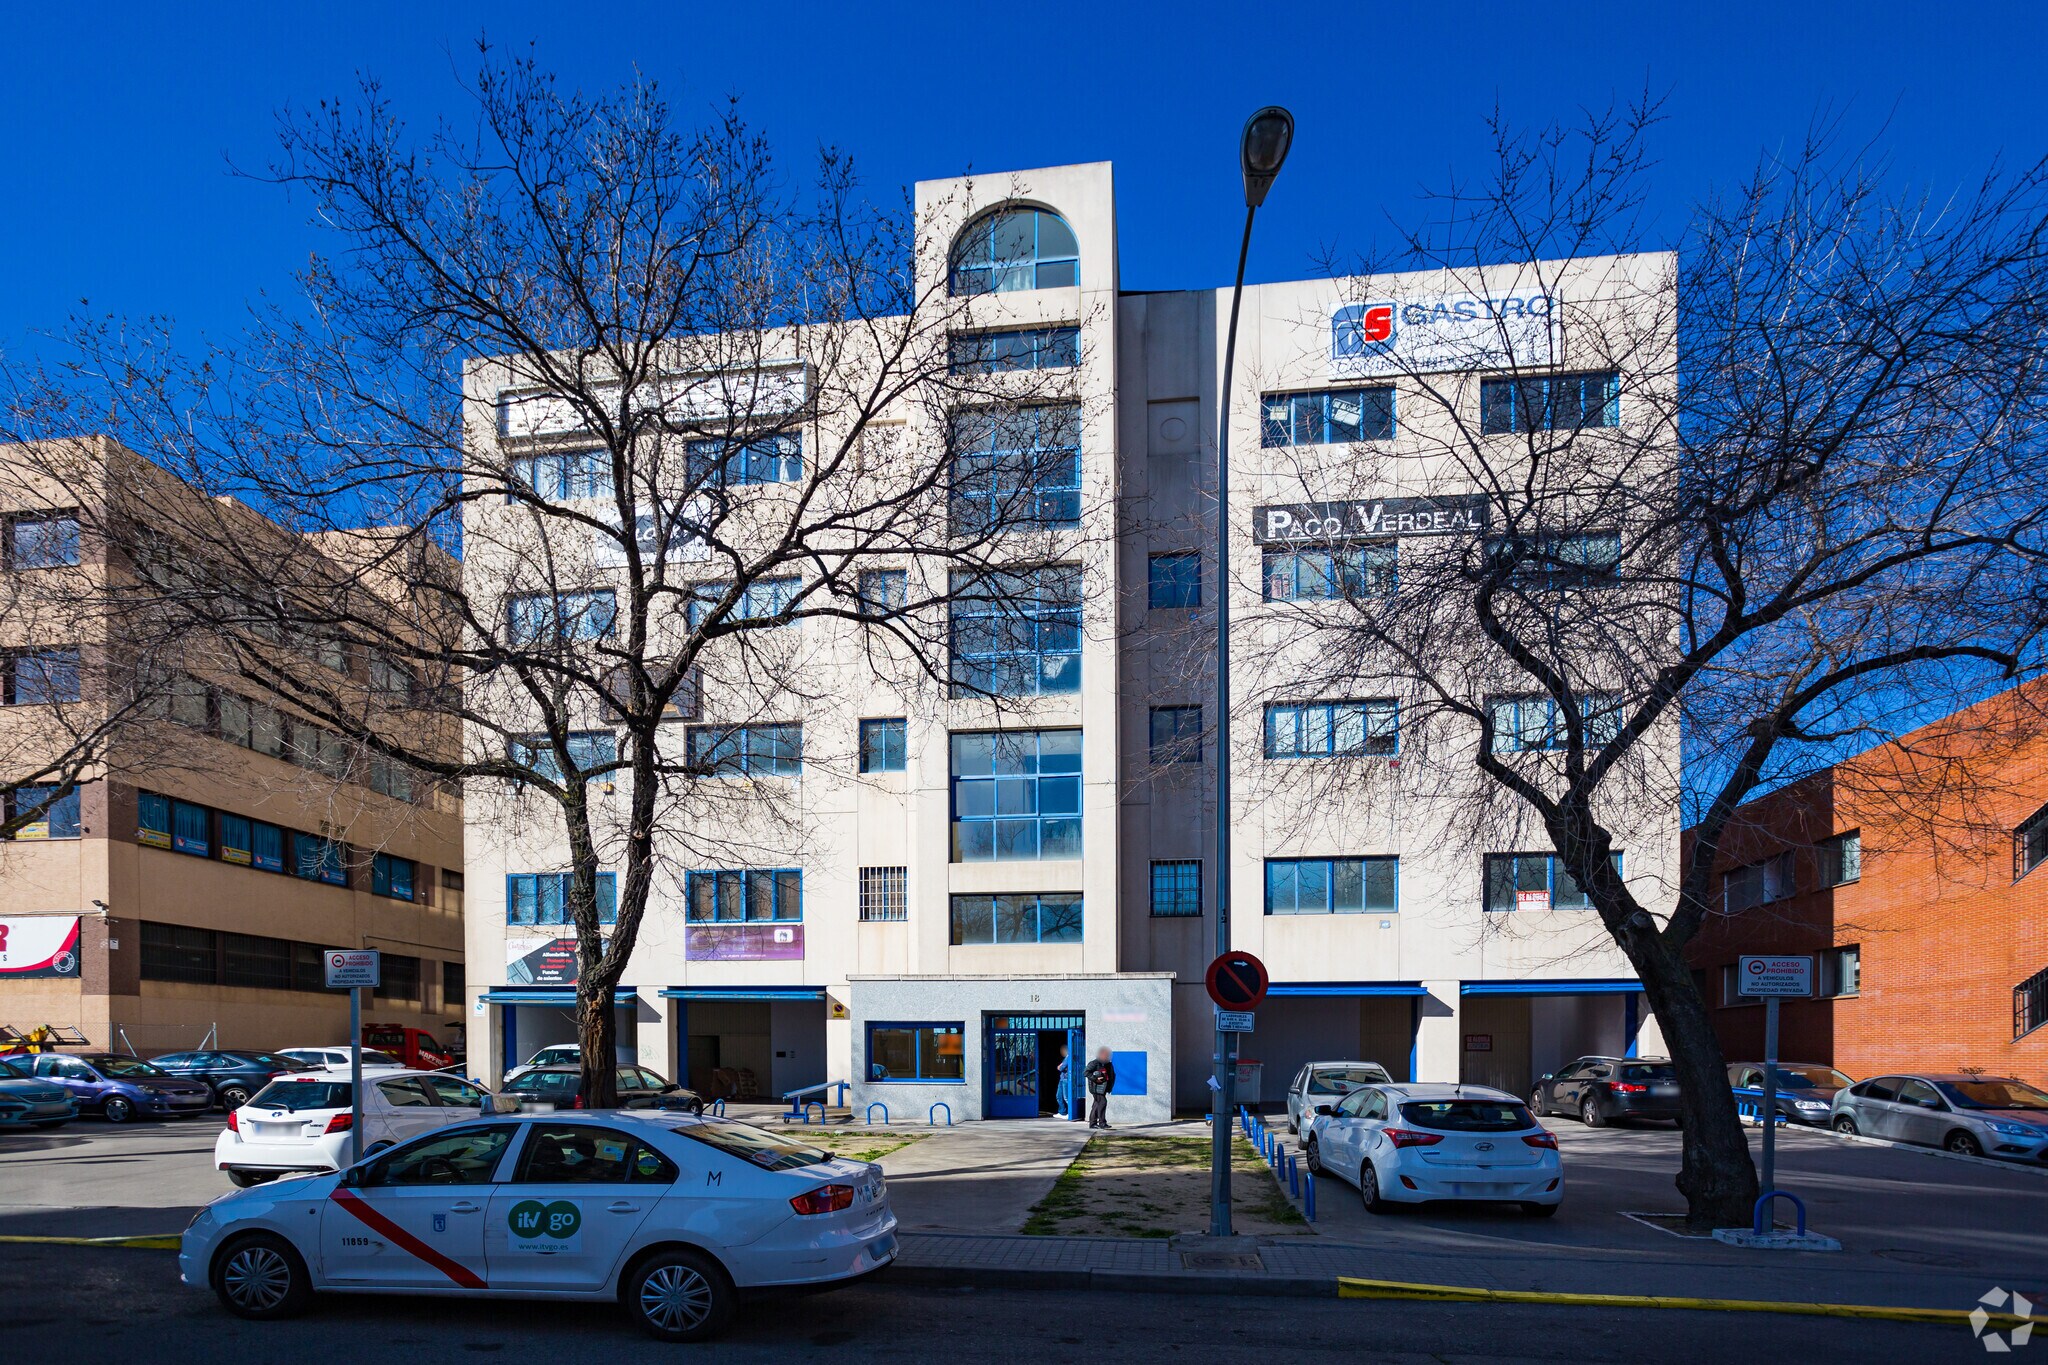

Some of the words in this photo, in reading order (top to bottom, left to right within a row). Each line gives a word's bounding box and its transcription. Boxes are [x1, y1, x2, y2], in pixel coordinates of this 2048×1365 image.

[1401, 295, 1553, 325] GASTRO
[1267, 510, 1342, 538] PACO
[1355, 504, 1481, 533] VERDEAL
[706, 1170, 722, 1187] M
[518, 1211, 541, 1228] itv
[549, 1213, 575, 1231] go
[341, 1237, 369, 1246] 11859
